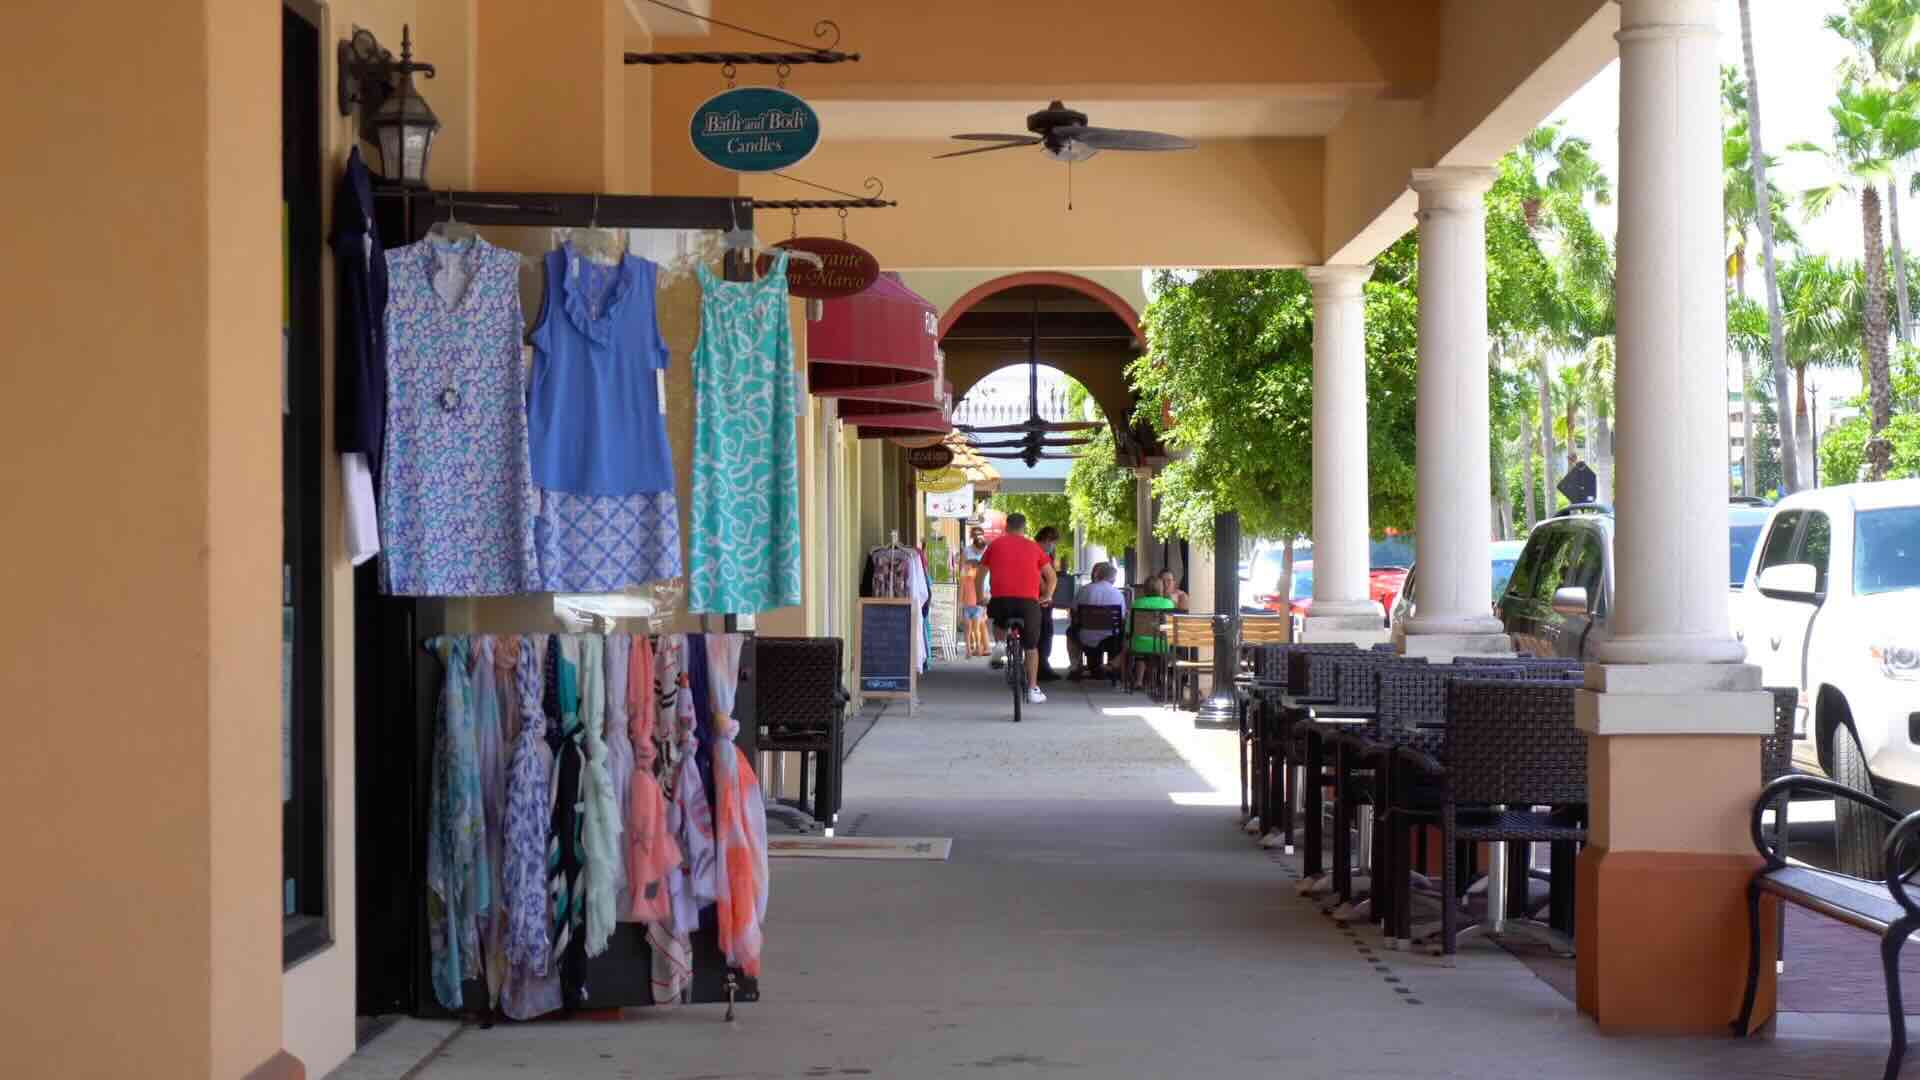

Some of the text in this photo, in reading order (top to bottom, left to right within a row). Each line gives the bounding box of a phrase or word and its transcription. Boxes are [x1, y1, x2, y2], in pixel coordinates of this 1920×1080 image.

[704, 109, 808, 132] Bath and Body
[727, 136, 784, 153] Candles
